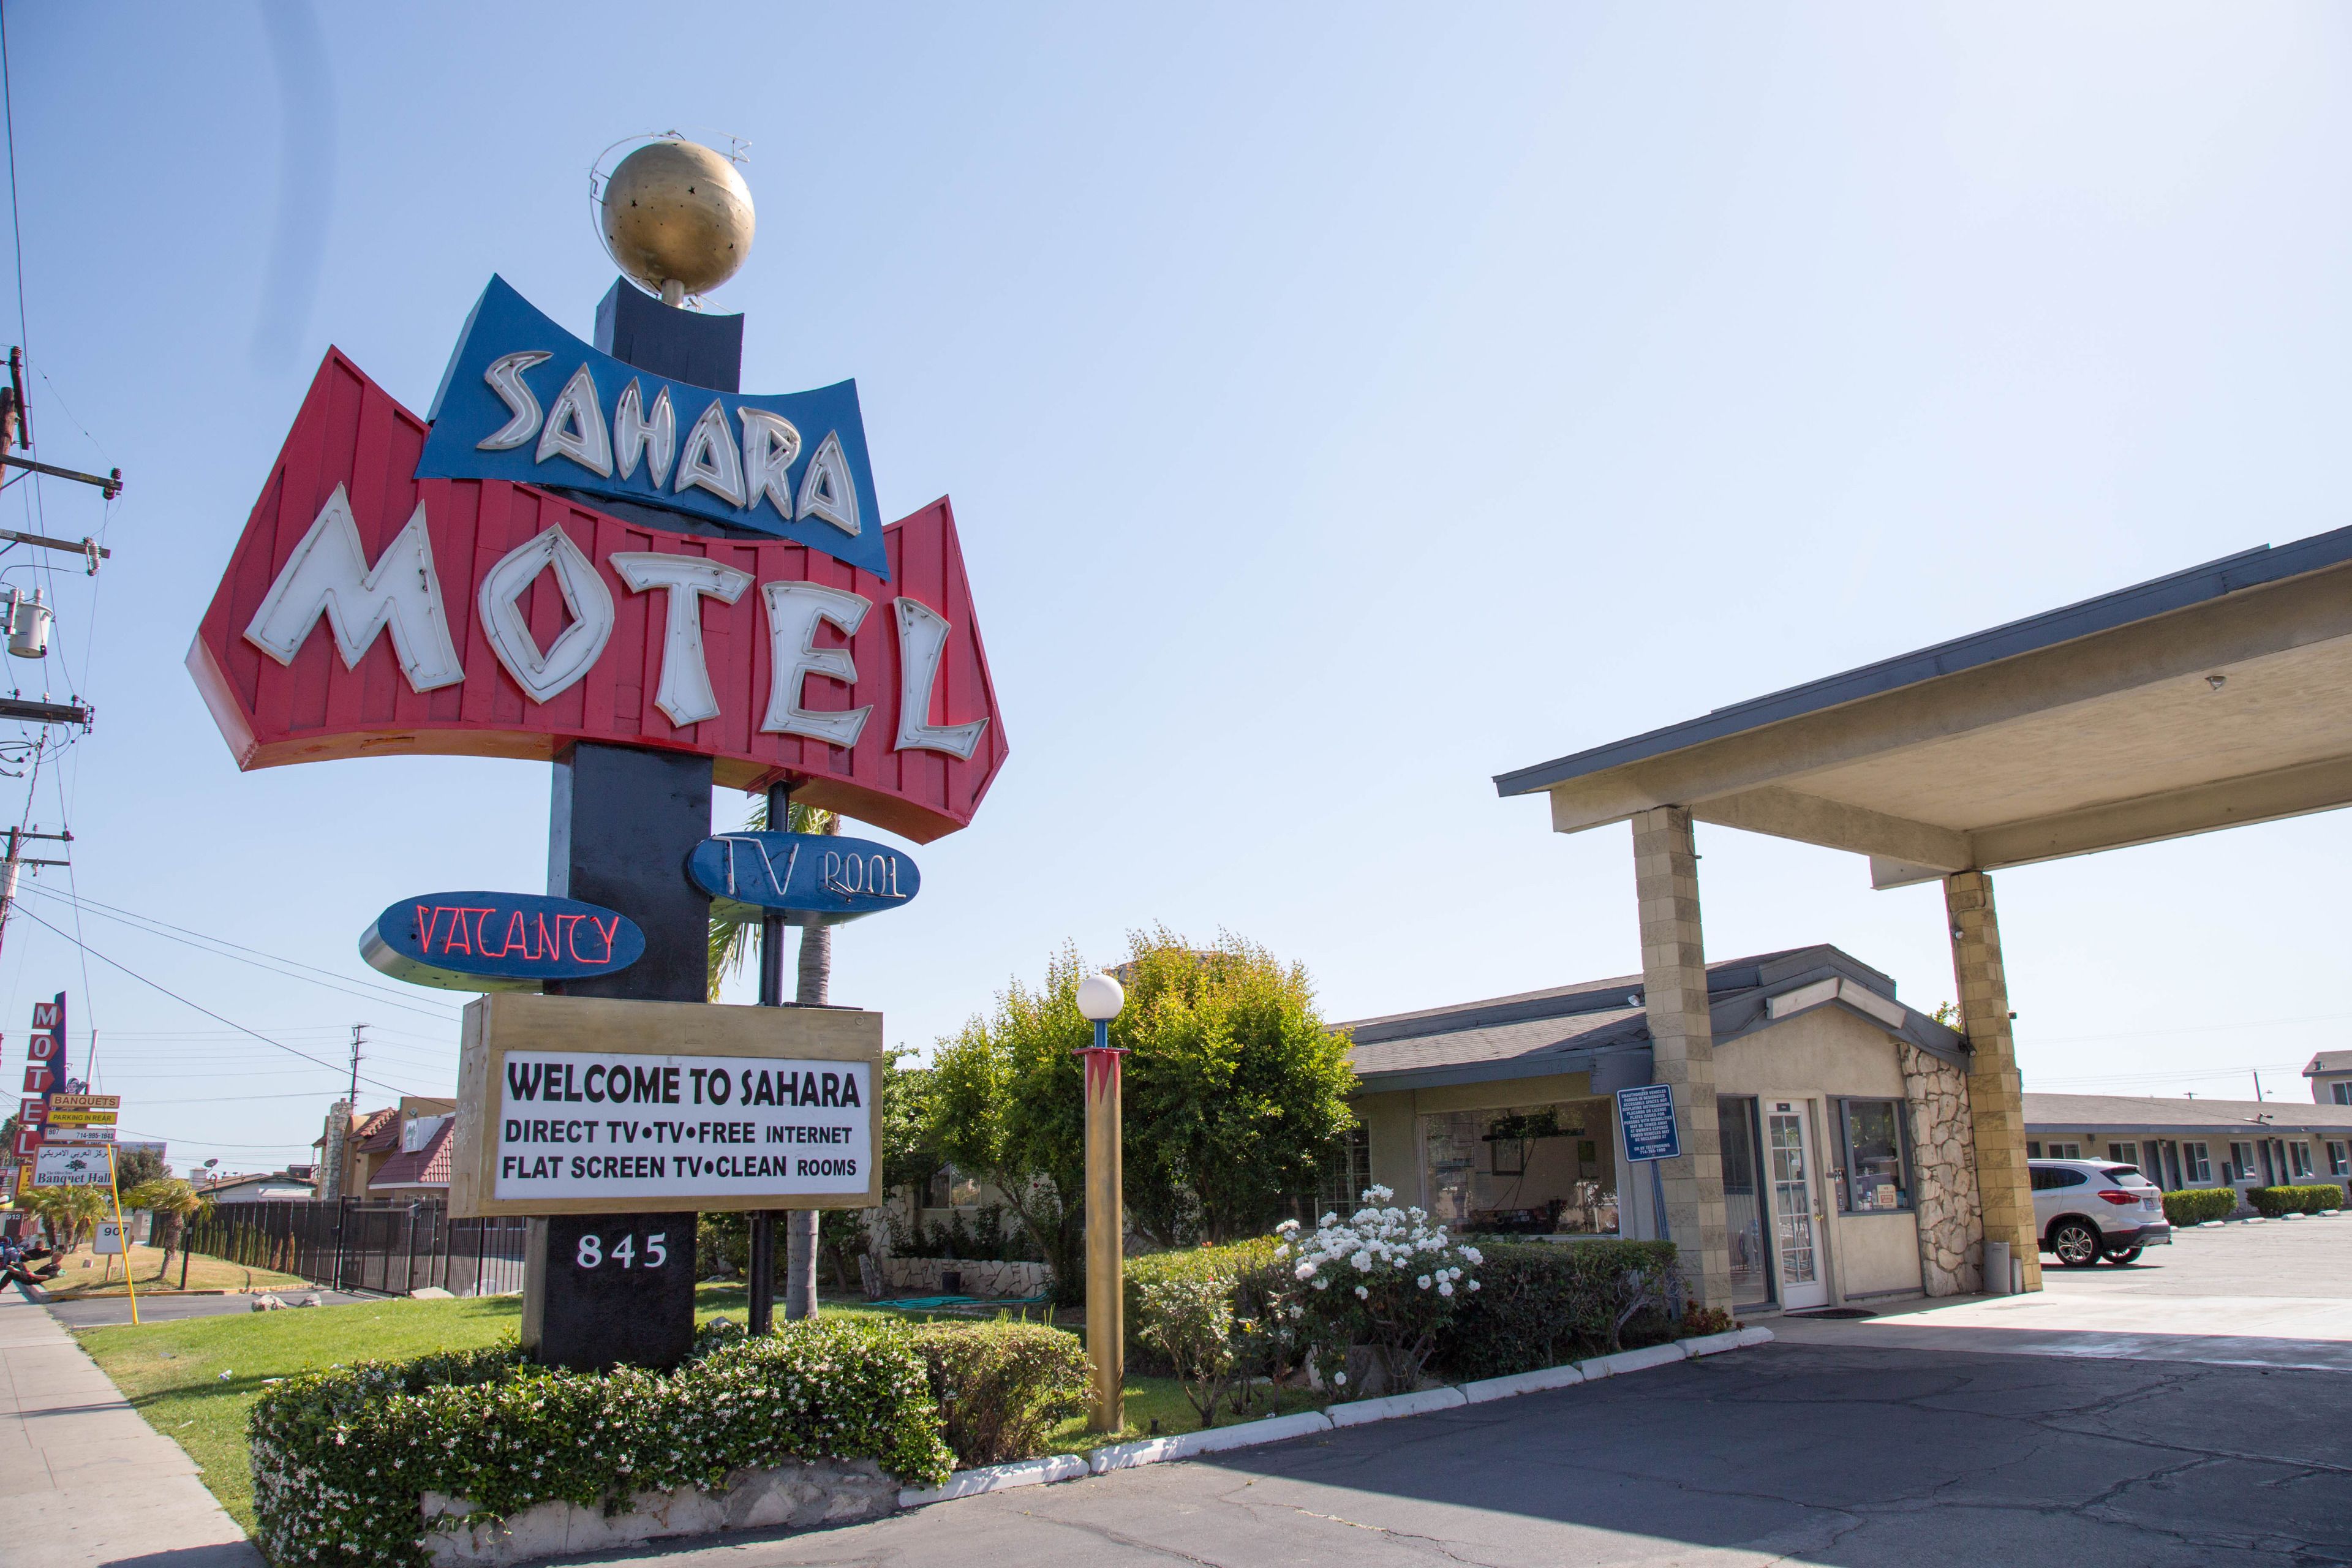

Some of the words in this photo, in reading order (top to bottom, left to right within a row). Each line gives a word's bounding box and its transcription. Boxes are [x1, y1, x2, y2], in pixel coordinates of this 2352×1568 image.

[476, 351, 862, 537] SAHARA
[244, 480, 989, 761] MOTEL
[711, 835, 799, 896] TV
[417, 905, 619, 963] VACANCY
[18, 1005, 58, 1155] MOTEL
[508, 1061, 680, 1104] WELCOME
[690, 1068, 731, 1105] TO
[741, 1069, 861, 1107] SAHARA
[55, 1096, 116, 1106] BANQUETS
[505, 1119, 599, 1143] DIRECT
[606, 1121, 639, 1143] TV
[699, 1122, 755, 1144] FREE
[766, 1126, 852, 1144] INTERNET
[37, 1172, 85, 1186] Banquet
[88, 1172, 111, 1183] Hall
[503, 1156, 564, 1178] FLAT
[571, 1156, 665, 1178] SCREEN
[673, 1156, 703, 1177] TV
[716, 1156, 786, 1177] CLEAN
[797, 1159, 856, 1176] ROOMS
[104, 1227, 128, 1236] 907
[577, 1232, 667, 1268] 845
